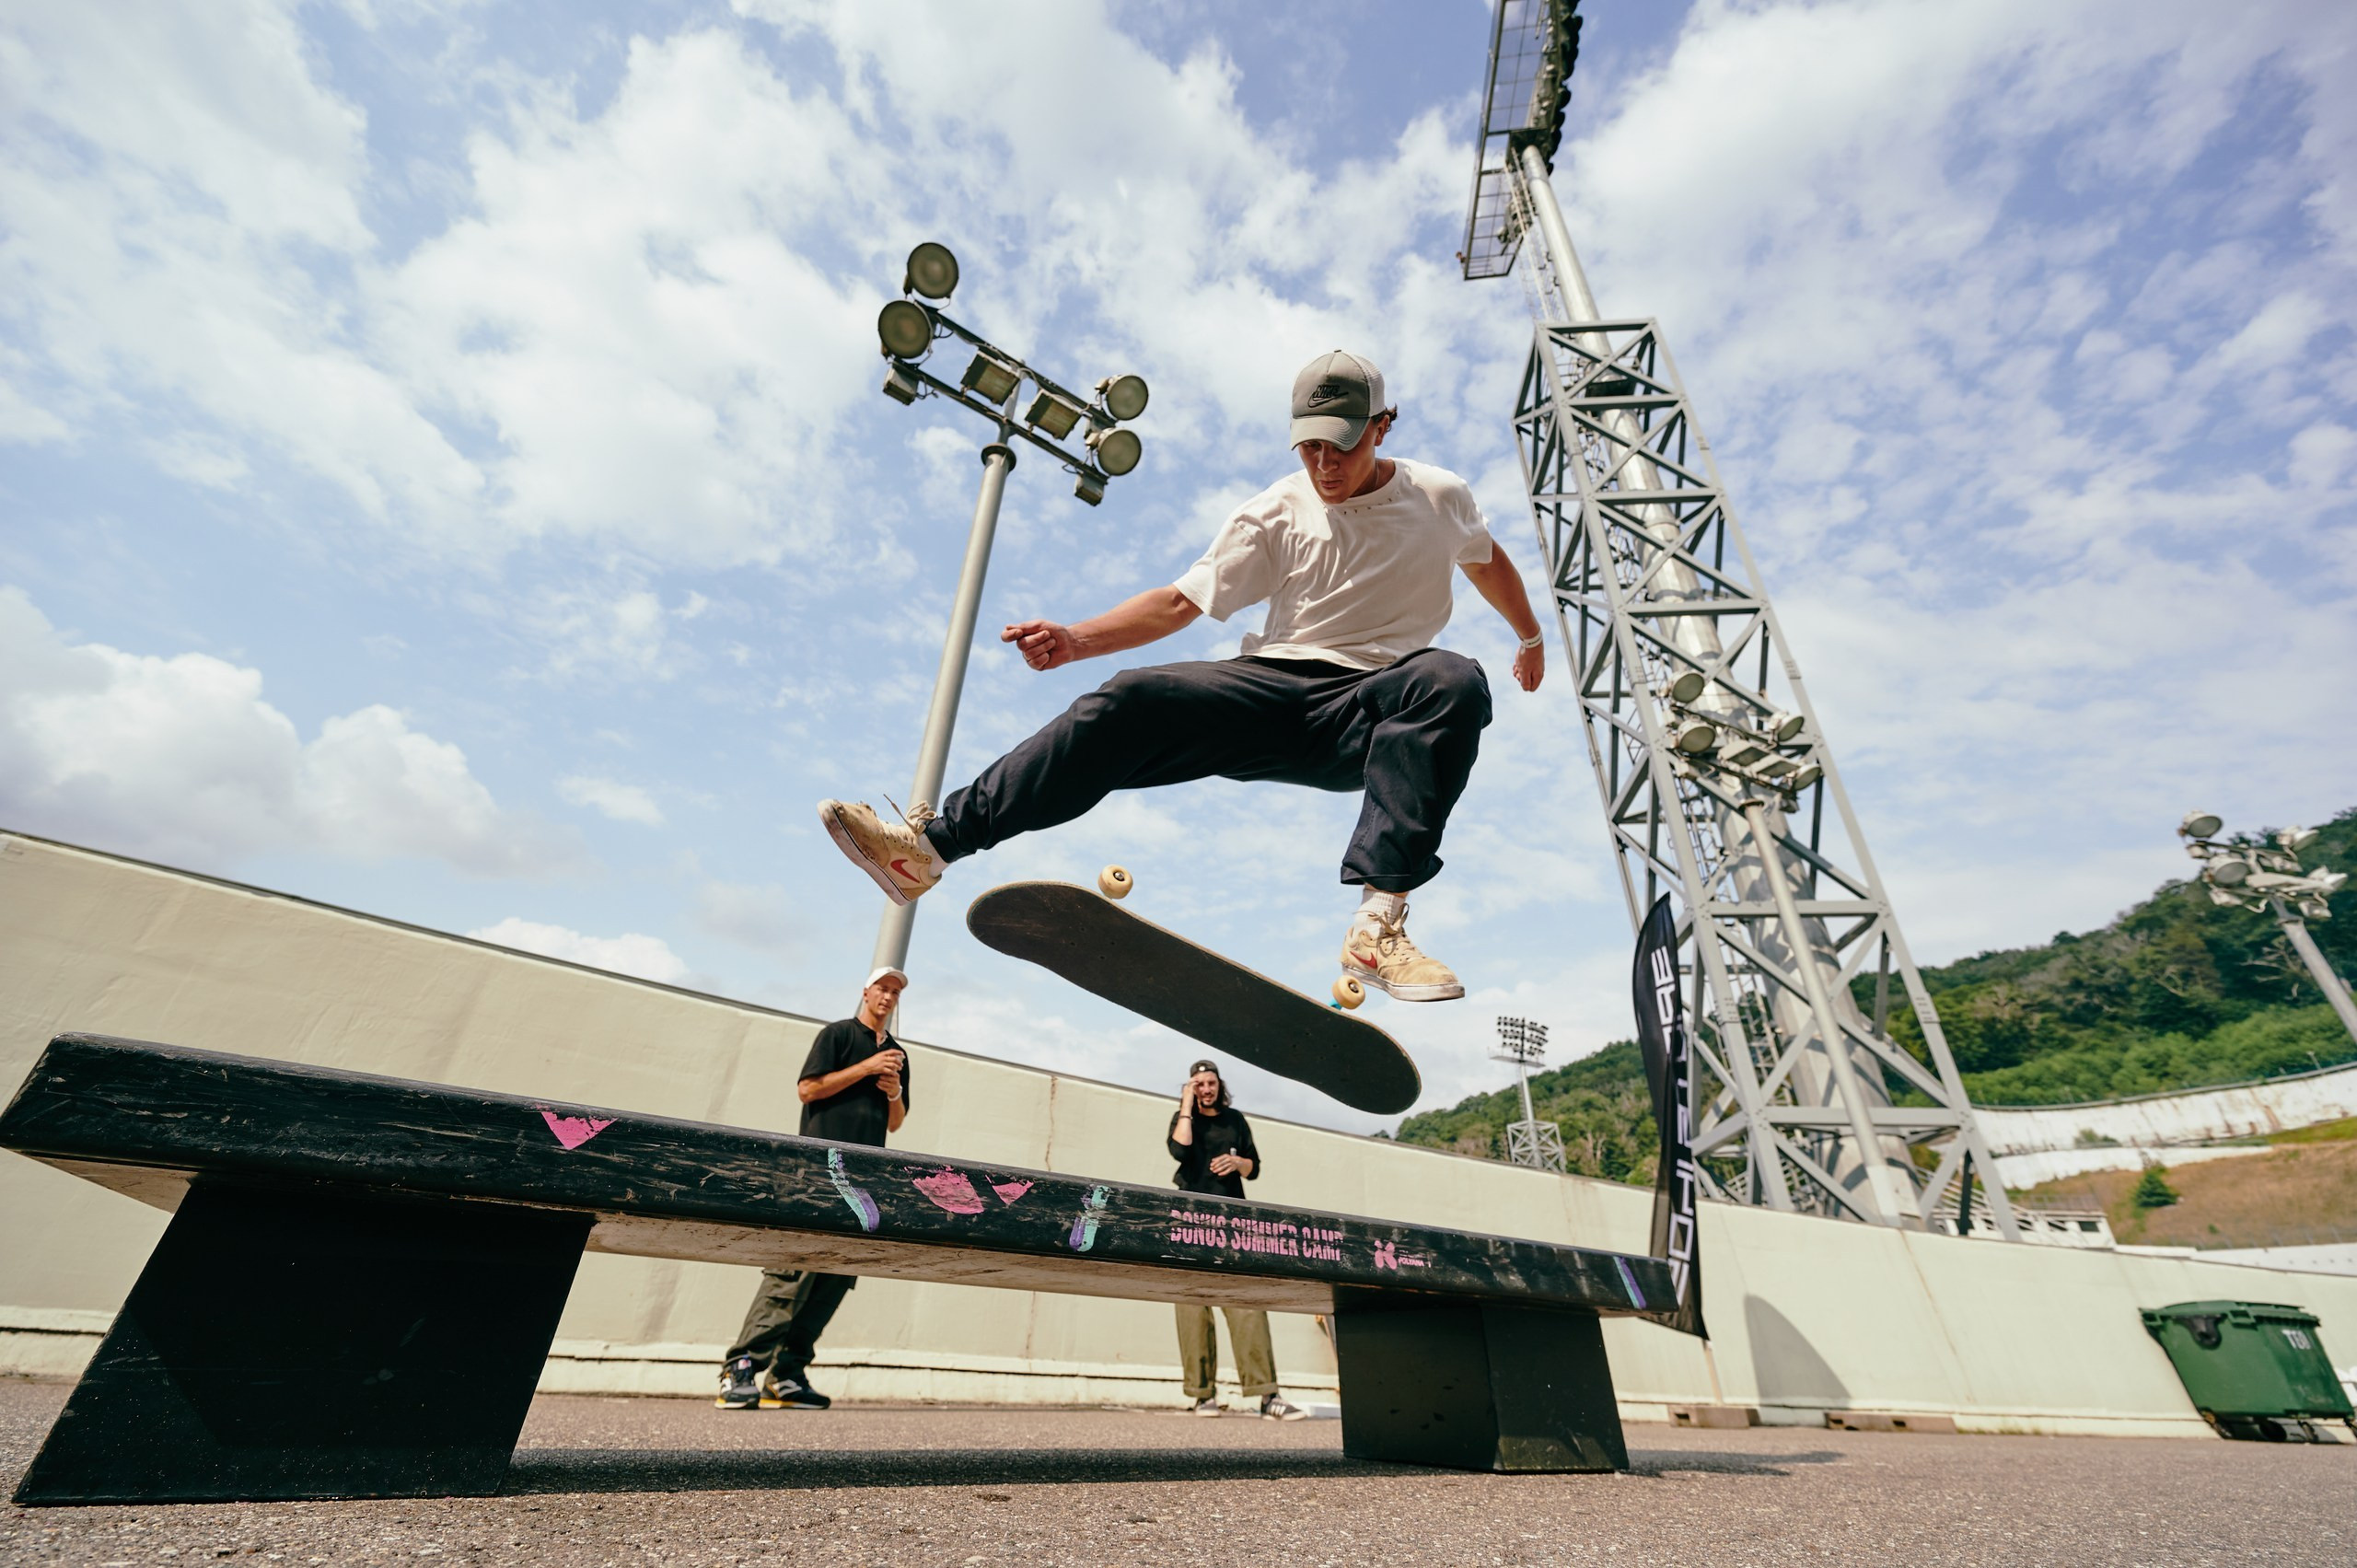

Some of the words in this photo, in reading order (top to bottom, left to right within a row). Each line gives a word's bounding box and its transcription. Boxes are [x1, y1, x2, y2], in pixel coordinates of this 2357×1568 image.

[1312, 384, 1341, 398] NIKE
[1230, 1217, 1299, 1257] SUMMER
[1302, 1226, 1344, 1261] CAMP
